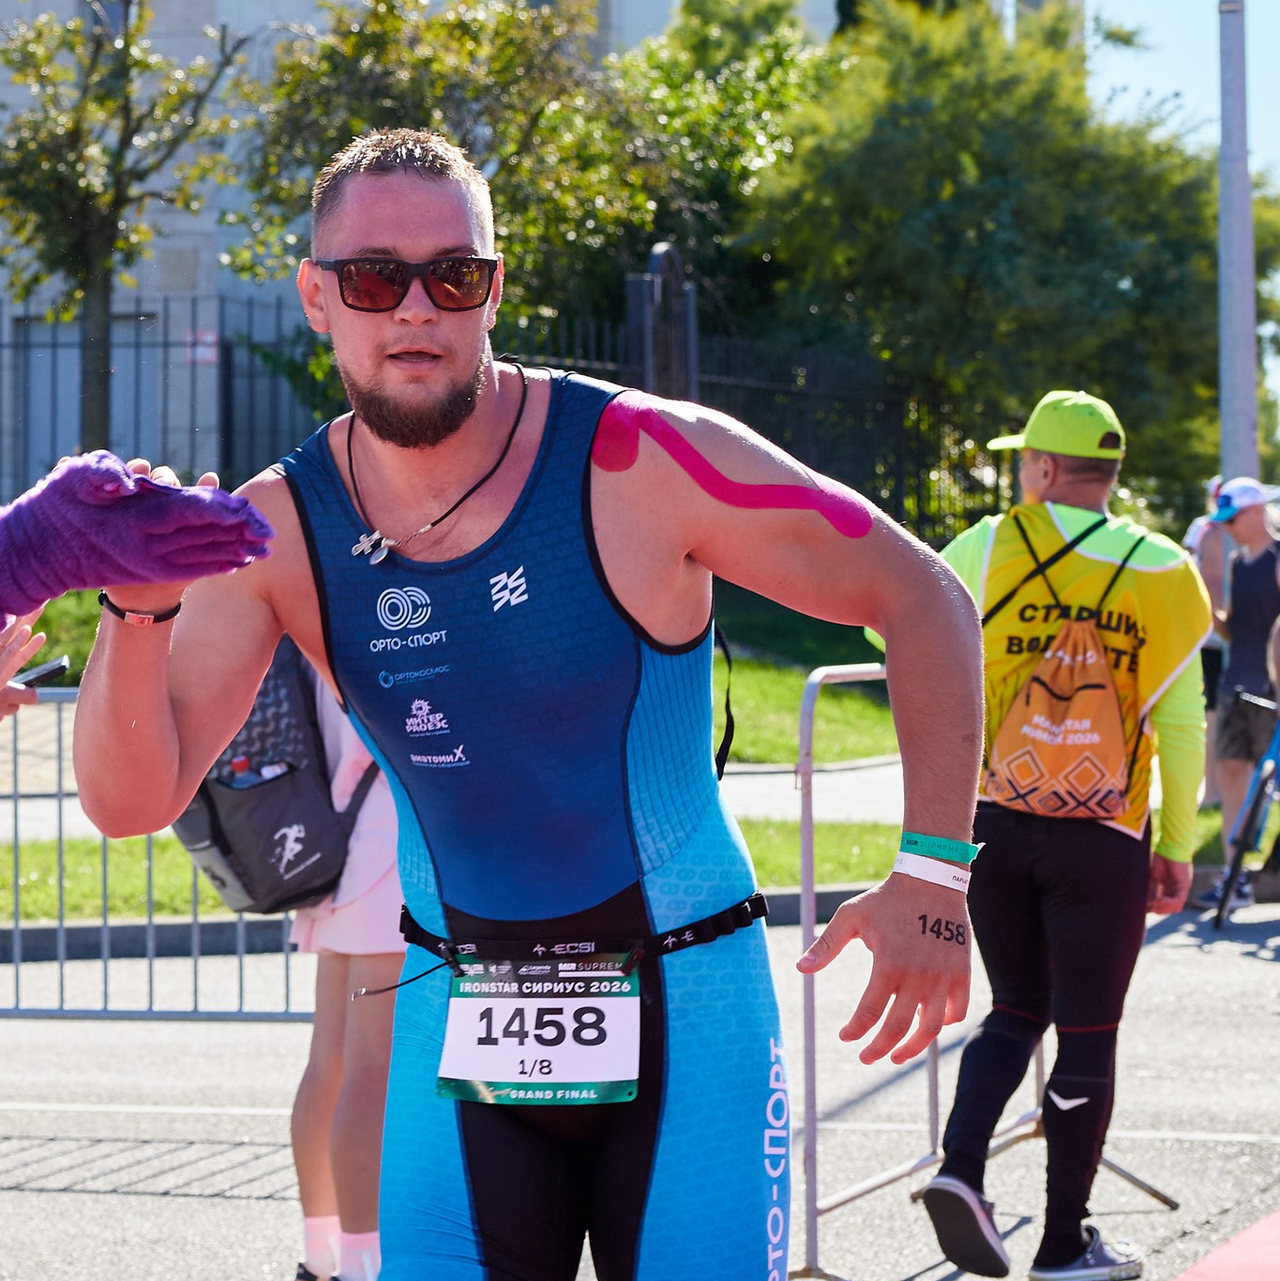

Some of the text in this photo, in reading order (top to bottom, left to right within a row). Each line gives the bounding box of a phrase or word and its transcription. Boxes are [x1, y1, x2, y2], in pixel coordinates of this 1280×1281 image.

[1019, 603, 1146, 638] СТАРШИ
[369, 630, 448, 652] ОРТО-СПОРТ
[918, 914, 966, 946] 1458
[578, 962, 623, 972] SUPREM
[459, 981, 632, 994] IRONSTAR СИРИУС 2026
[476, 1006, 607, 1047] 1458
[518, 1058, 553, 1078] 1/8
[509, 1089, 554, 1100] GRAND
[556, 1089, 598, 1100] FINAL
